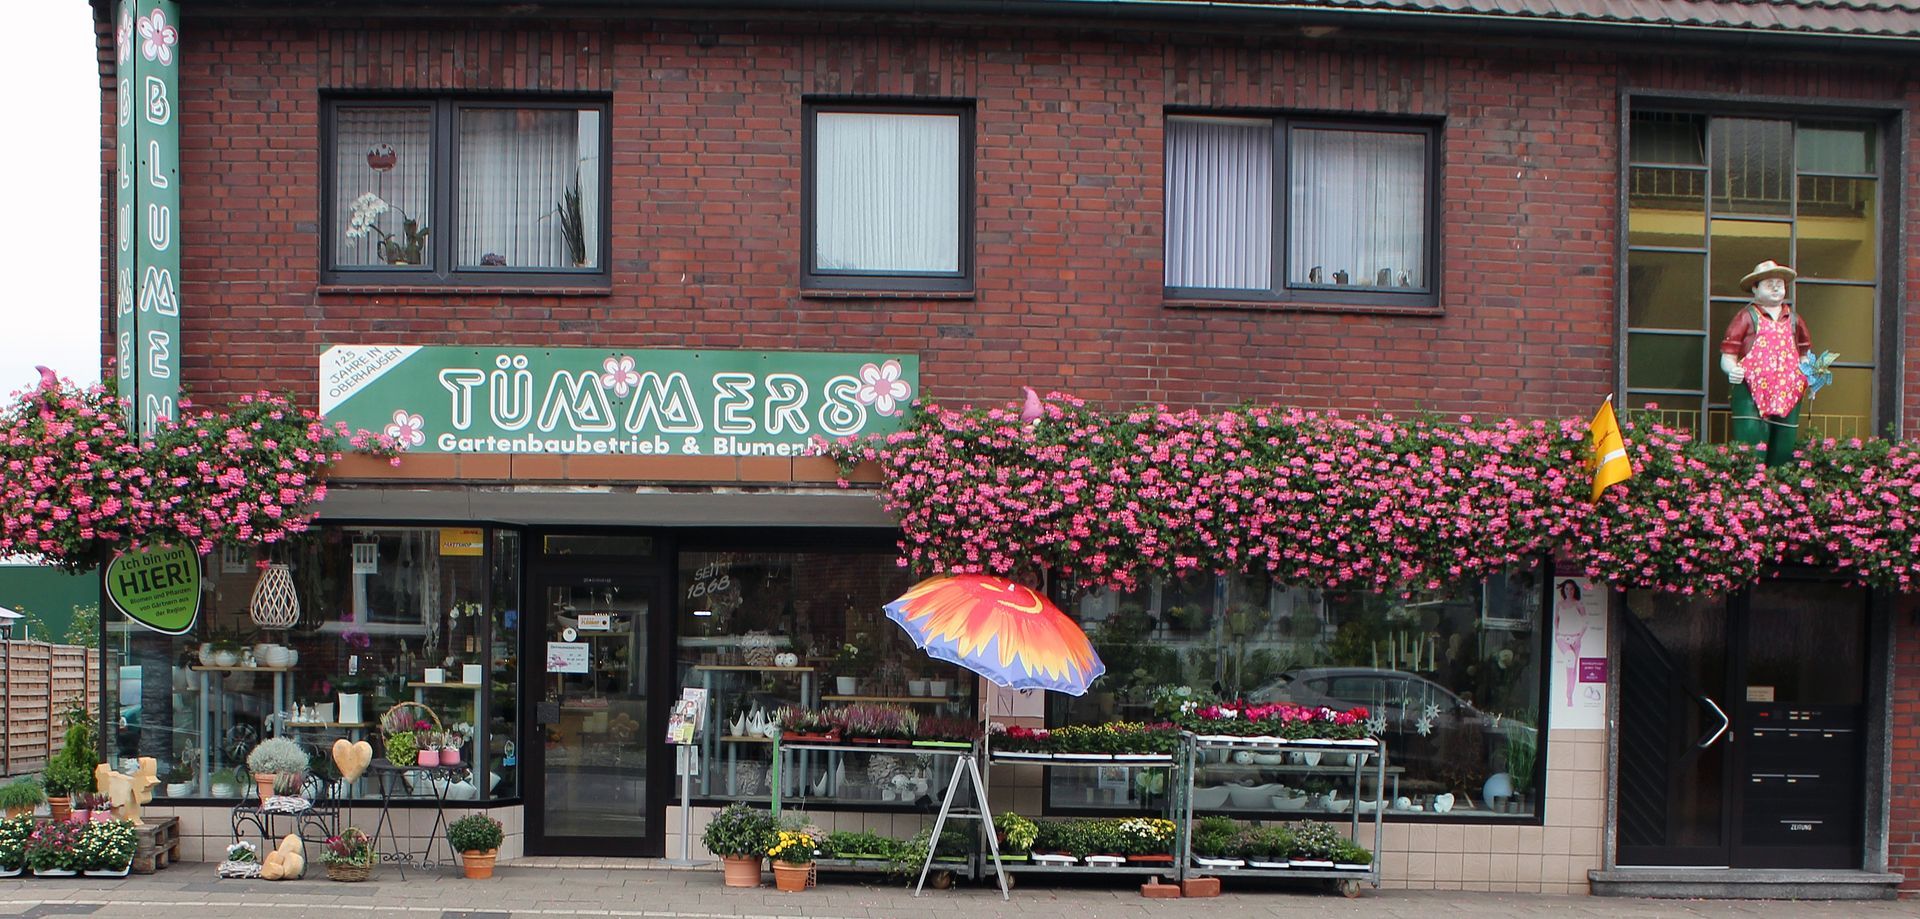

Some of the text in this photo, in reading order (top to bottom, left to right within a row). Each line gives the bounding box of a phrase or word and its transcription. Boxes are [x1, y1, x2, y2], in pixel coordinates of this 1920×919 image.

[140, 75, 179, 439] BLUMEN
[329, 346, 382, 384] JAHRE IN
[334, 350, 356, 367] 125
[329, 346, 403, 398] OBERHAUSEN
[438, 354, 868, 436] TÜMMERS
[437, 432, 670, 454] Gartenbaubetrieb
[681, 435, 702, 455] &
[120, 549, 186, 571] Ich bin von
[118, 560, 192, 597] HIER!
[694, 562, 721, 581] SEIT
[153, 592, 165, 600] und
[166, 588, 191, 596] Pflanzen
[687, 575, 730, 600] 1868
[151, 599, 178, 609] Gärtnern
[166, 606, 187, 614] Region
[1790, 823, 1812, 831] ZEITUNG
